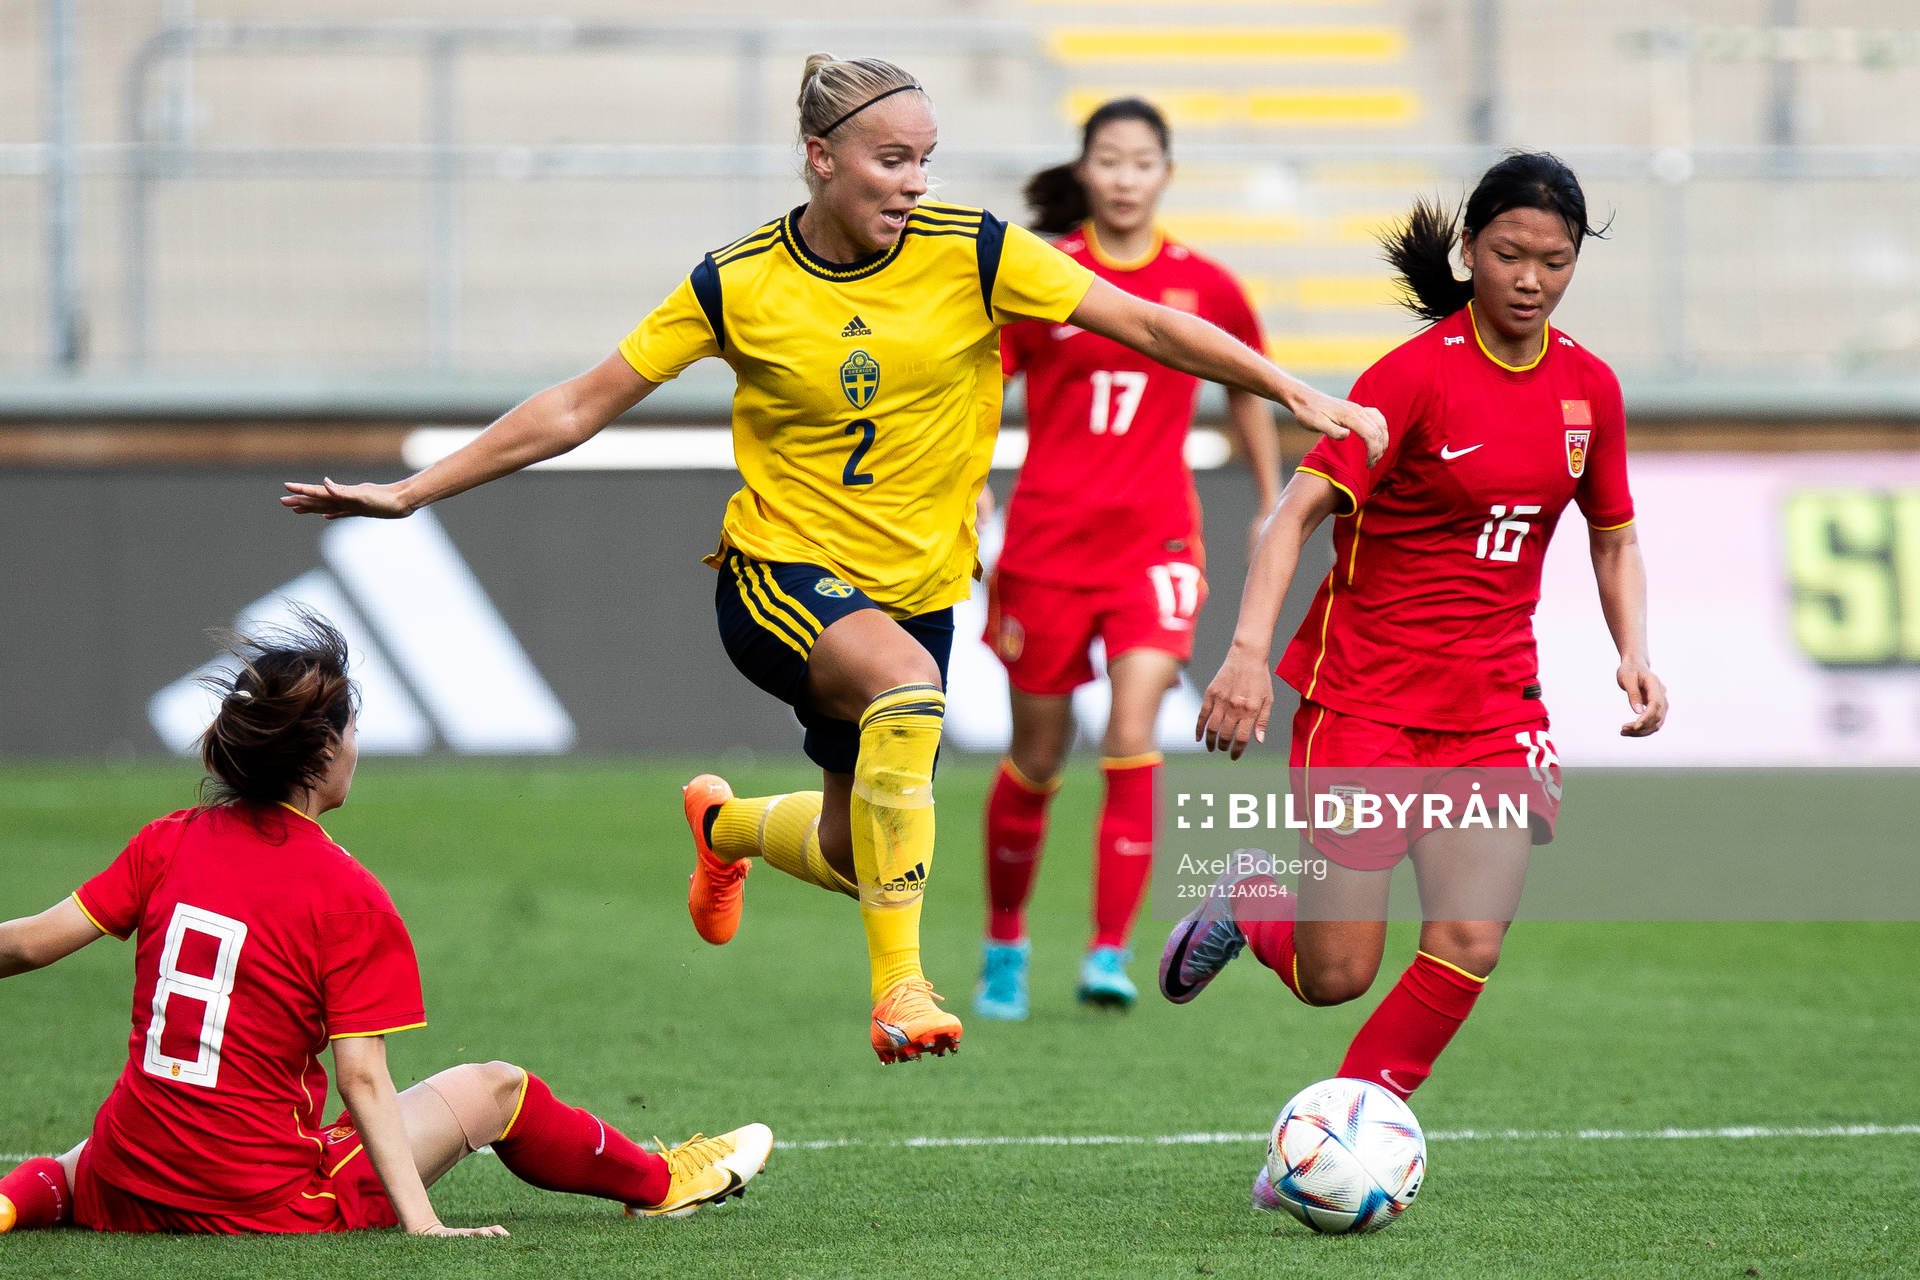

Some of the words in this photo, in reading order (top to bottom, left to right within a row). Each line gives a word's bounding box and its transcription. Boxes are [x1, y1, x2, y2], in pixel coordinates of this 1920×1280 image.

[841, 328, 871, 337] adidas
[1090, 370, 1148, 435] 17
[842, 418, 876, 486] 2
[1475, 504, 1541, 562] 16
[1782, 488, 1920, 665] S
[883, 880, 925, 892] adida
[143, 902, 248, 1088] 8
